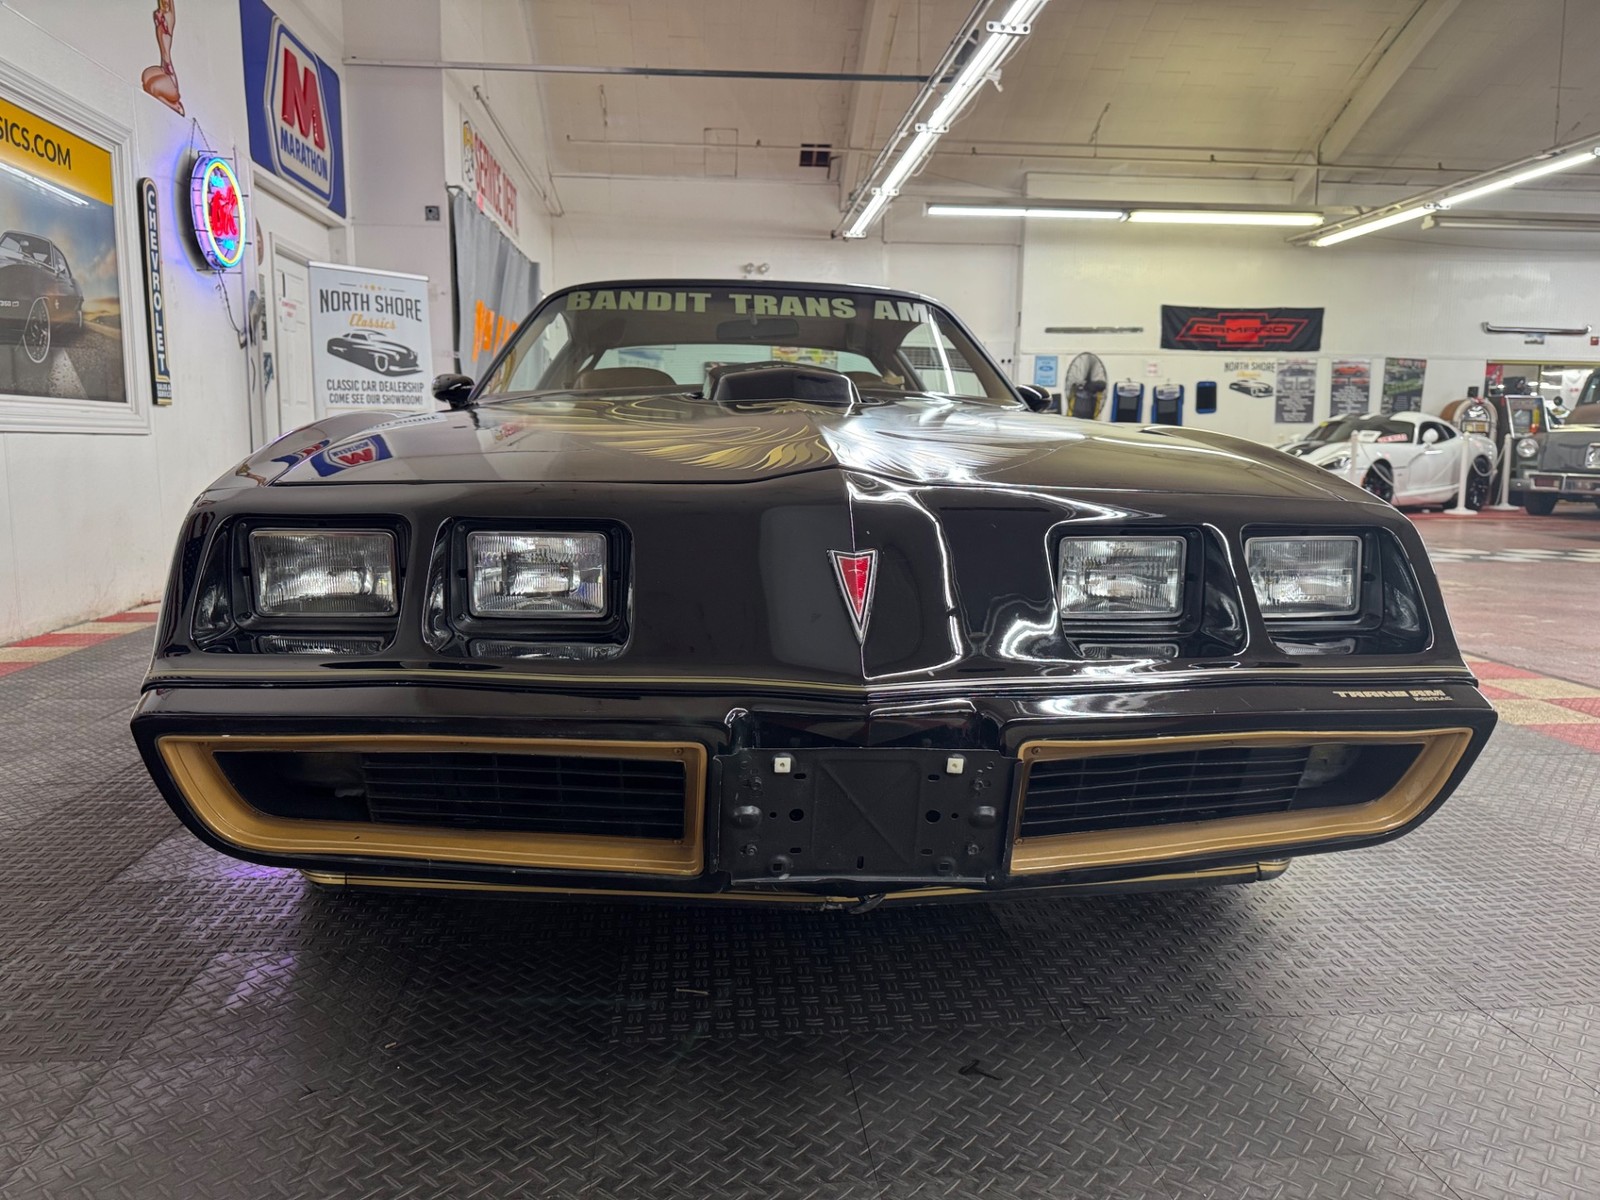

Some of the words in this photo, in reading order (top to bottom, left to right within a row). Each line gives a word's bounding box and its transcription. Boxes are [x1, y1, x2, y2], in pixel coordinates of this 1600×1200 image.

[282, 47, 326, 152] M
[280, 127, 328, 181] MARATHON
[148, 190, 166, 373] CHEVROLET
[319, 288, 370, 313] NORTH
[375, 295, 422, 322] SHORE
[566, 290, 712, 312] BANDIT
[729, 294, 857, 318] TRANS
[874, 300, 929, 323] AM
[349, 313, 397, 329] Classics
[1196, 325, 1288, 334] CAMARO
[1251, 361, 1275, 374] SHORE
[326, 379, 359, 392] CLASSIC
[361, 381, 377, 392] CAR
[379, 381, 424, 393] DEALERSHIP
[329, 393, 350, 404] COME
[351, 393, 364, 404] SEE
[366, 394, 381, 404] OUR
[1333, 690, 1410, 698] TRANS
[1408, 689, 1446, 697] AM
